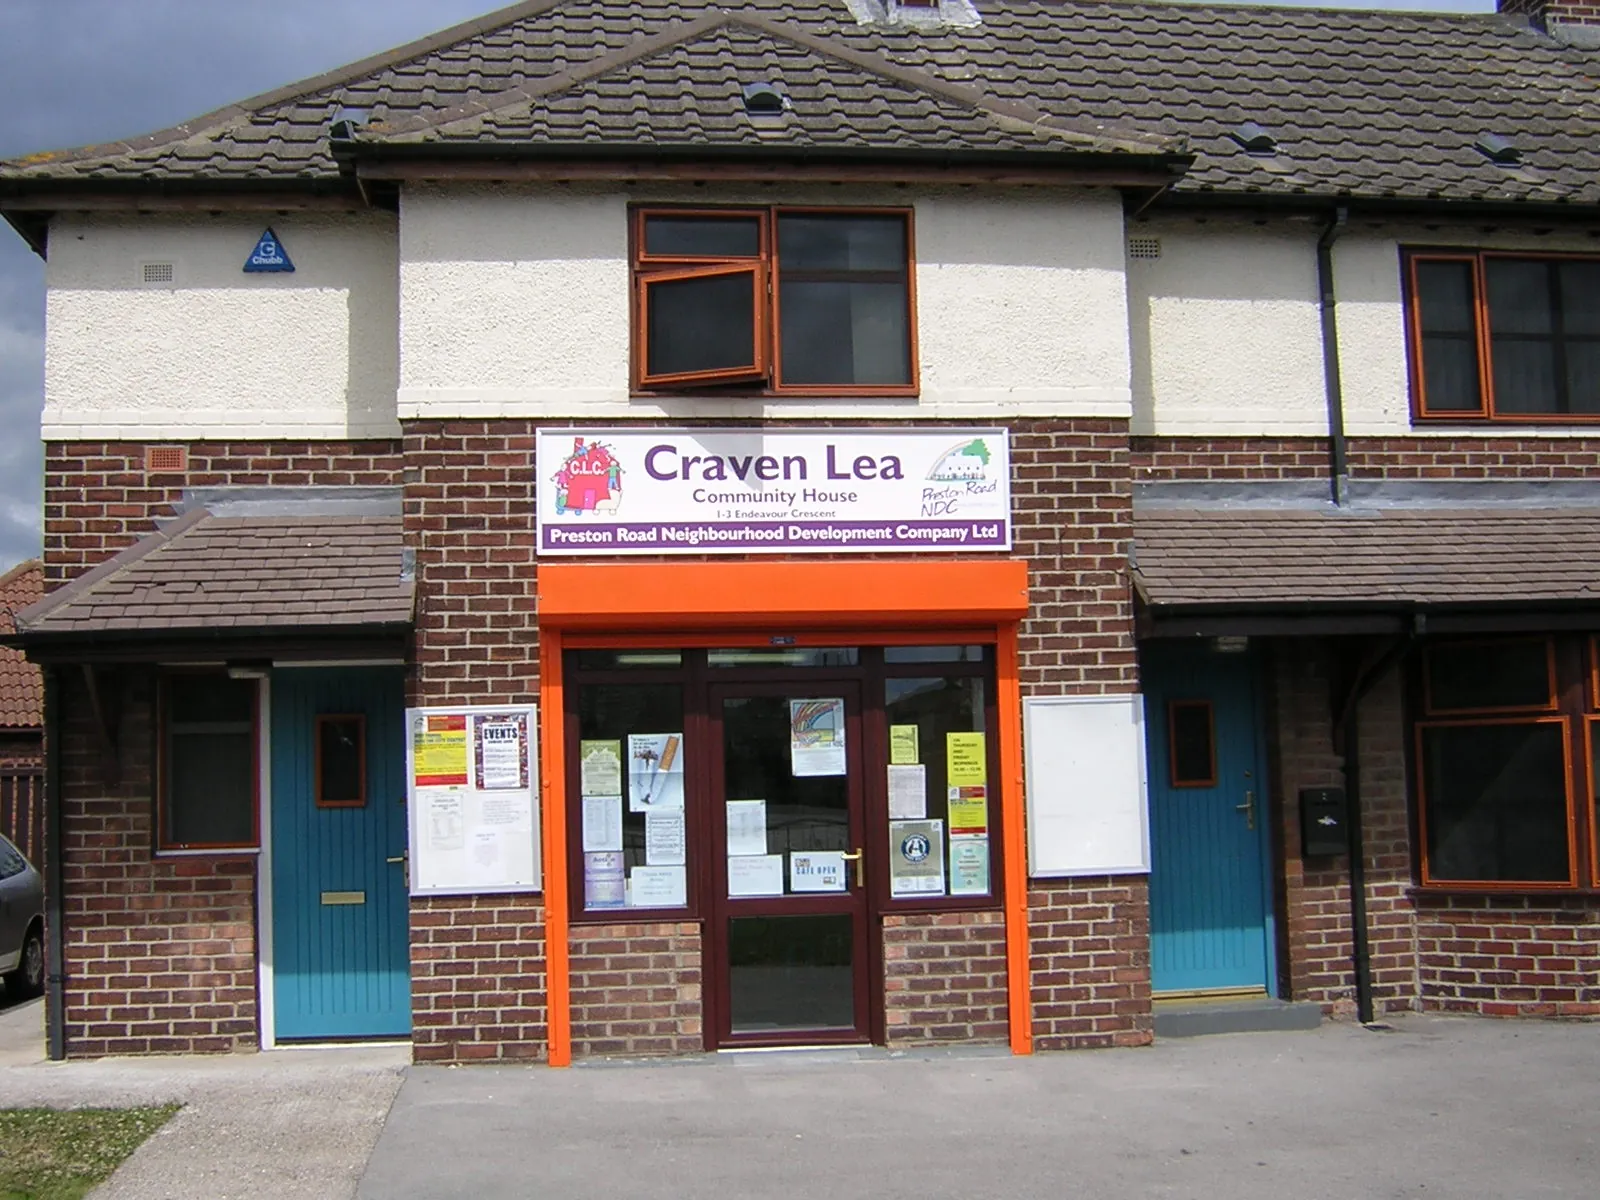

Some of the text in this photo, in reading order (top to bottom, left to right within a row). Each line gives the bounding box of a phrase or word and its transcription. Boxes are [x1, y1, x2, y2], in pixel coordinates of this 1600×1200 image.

[252, 256, 283, 265] Chubb
[644, 444, 905, 481] Craven Lea
[693, 488, 858, 507] Community House
[922, 479, 997, 502] Preston Road
[717, 509, 836, 518] 1-3 Endeavour Crescent
[921, 499, 958, 517] NDC
[550, 524, 998, 545] Preston Road Neighbourhood Development Company Ltd
[484, 727, 517, 739] EVENTS
